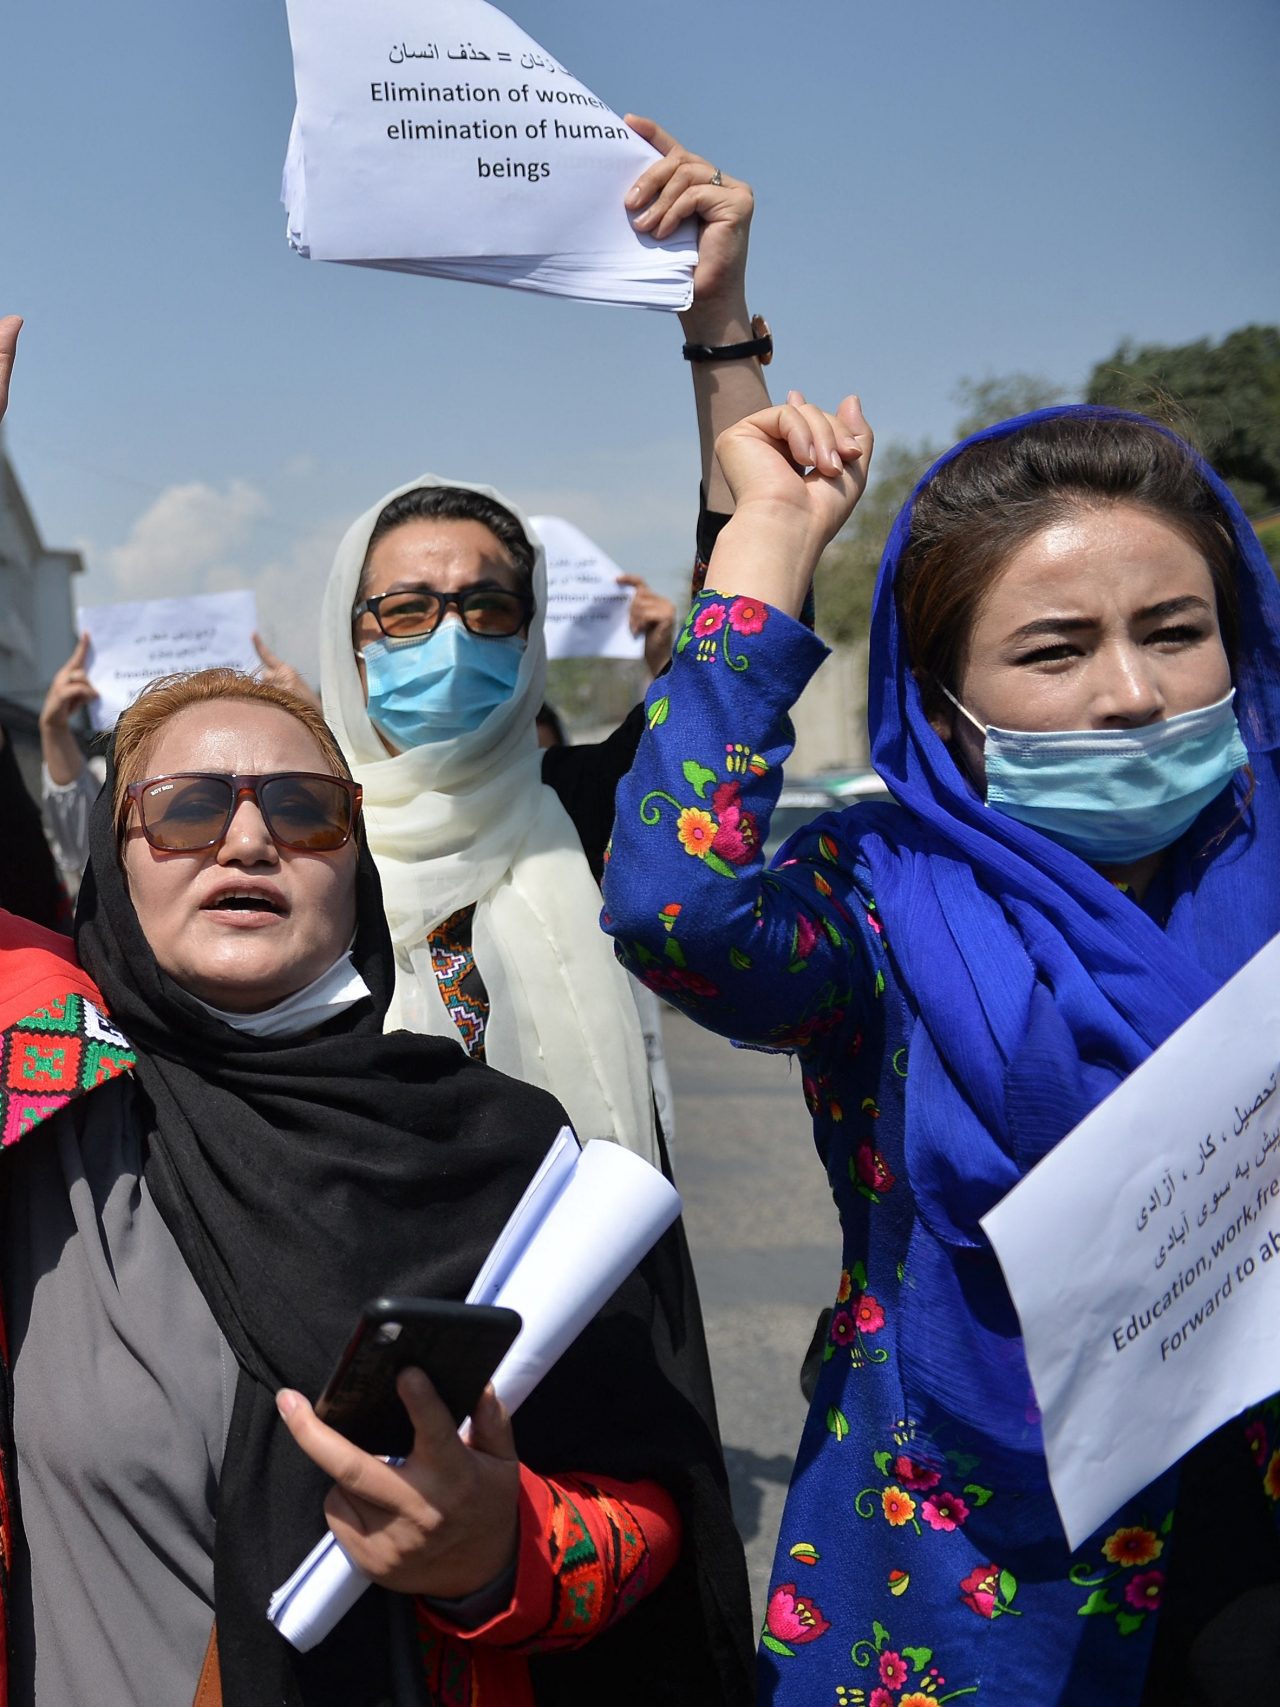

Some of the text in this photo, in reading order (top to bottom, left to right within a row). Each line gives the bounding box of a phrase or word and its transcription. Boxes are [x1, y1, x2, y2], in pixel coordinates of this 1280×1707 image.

[388, 42, 440, 64] انسان
[447, 42, 491, 60] حذف
[370, 81, 500, 102] Elimination
[508, 84, 529, 102] of
[387, 119, 629, 140] elimination of human
[477, 156, 551, 182] beings
[1233, 1072, 1277, 1137] تحصیل
[1196, 1133, 1217, 1176] کار
[1235, 1161, 1250, 1180] به
[1136, 1167, 1176, 1232] آزادی
[1197, 1181, 1232, 1228] سوی
[1154, 1210, 1190, 1270] آبادی
[1112, 1178, 1280, 1353] Education,work,fre
[1160, 1230, 1280, 1362] Forward to ab
